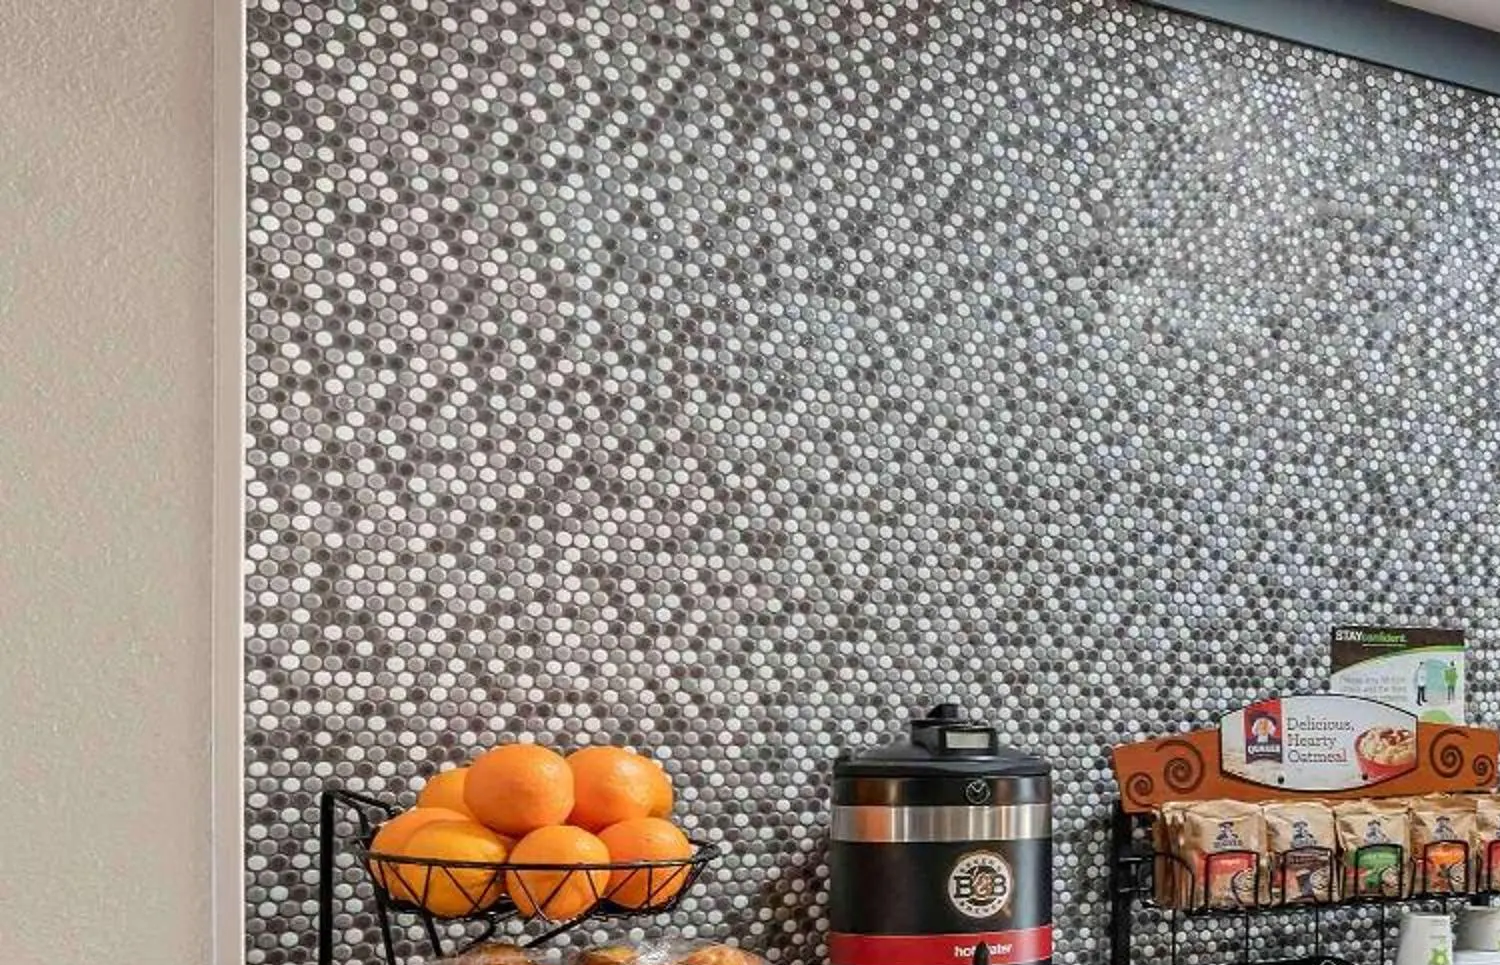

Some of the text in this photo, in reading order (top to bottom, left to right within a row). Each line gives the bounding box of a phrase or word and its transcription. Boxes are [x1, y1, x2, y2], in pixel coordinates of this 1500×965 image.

[1287, 716, 1355, 731] Delicious,
[1287, 733, 1337, 749] Hearty
[1287, 747, 1347, 763] Oatmeal
[986, 943, 1013, 956] ater
